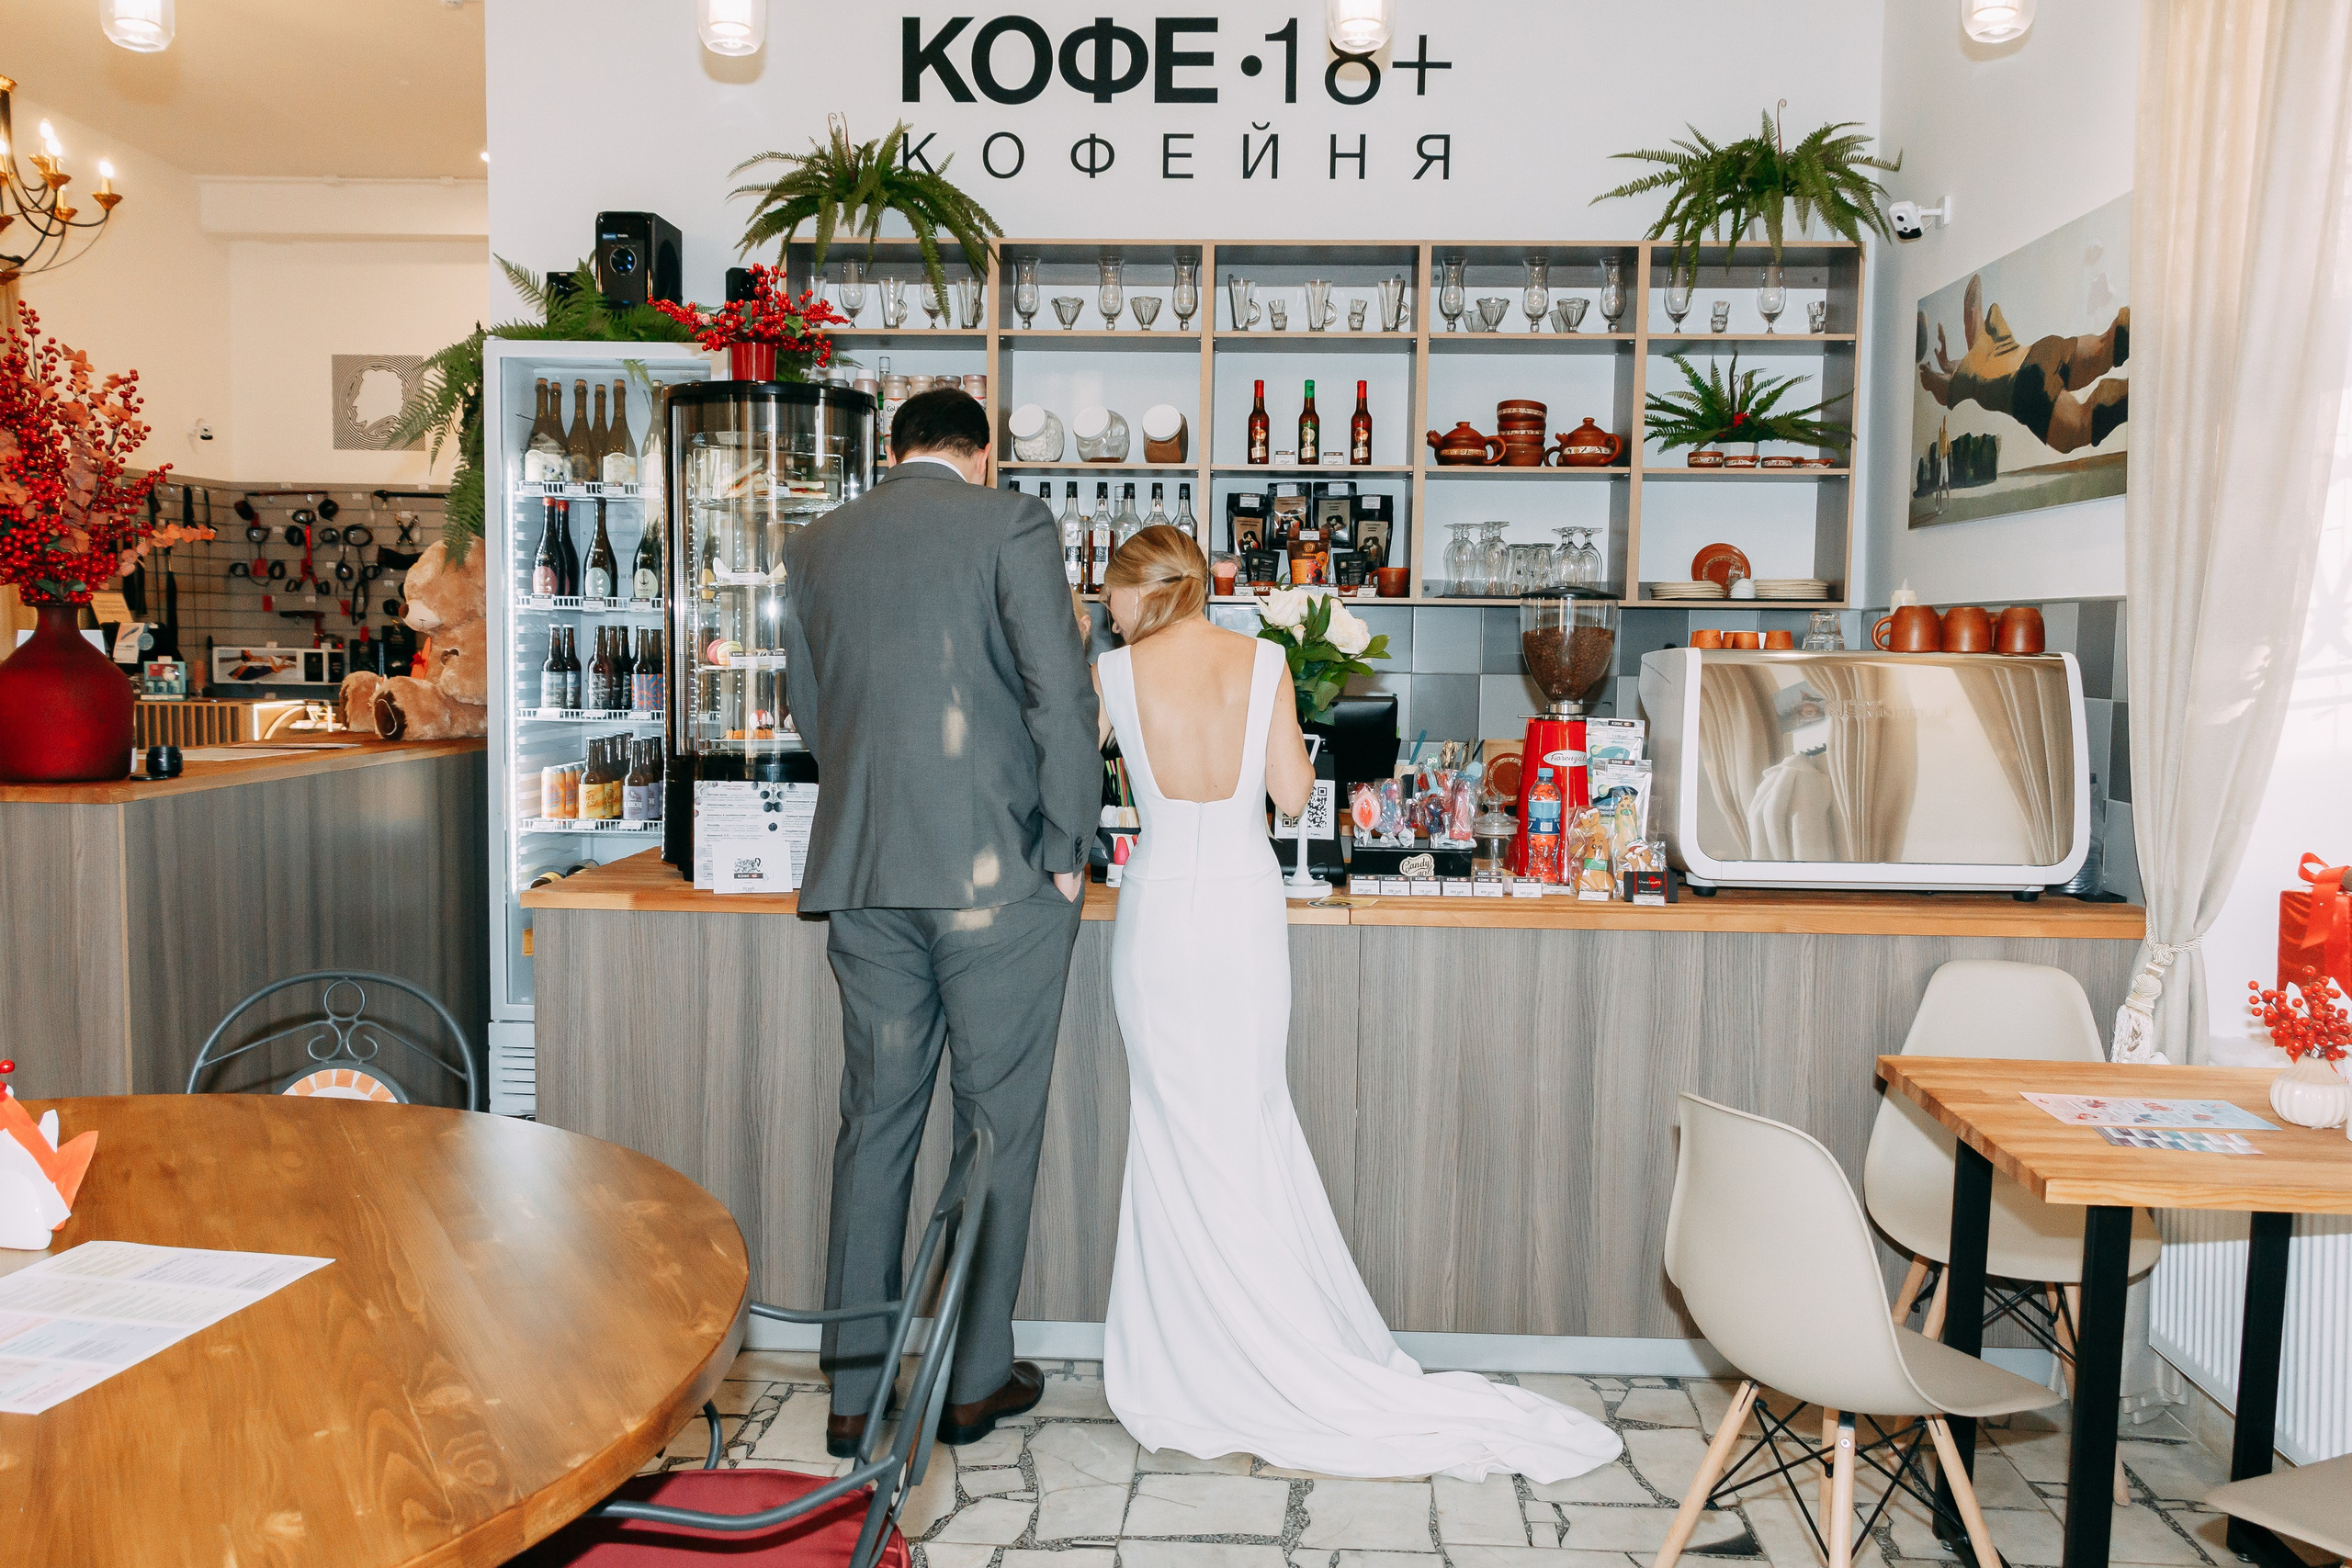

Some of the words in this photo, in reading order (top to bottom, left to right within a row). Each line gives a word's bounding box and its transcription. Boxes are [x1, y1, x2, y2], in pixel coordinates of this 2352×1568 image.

[902, 16, 1218, 105] КОФЕ
[902, 121, 1451, 180] КОФЕЙНЯ
[1550, 752, 1588, 765] Fiorenzat
[1401, 856, 1431, 874] Candy
